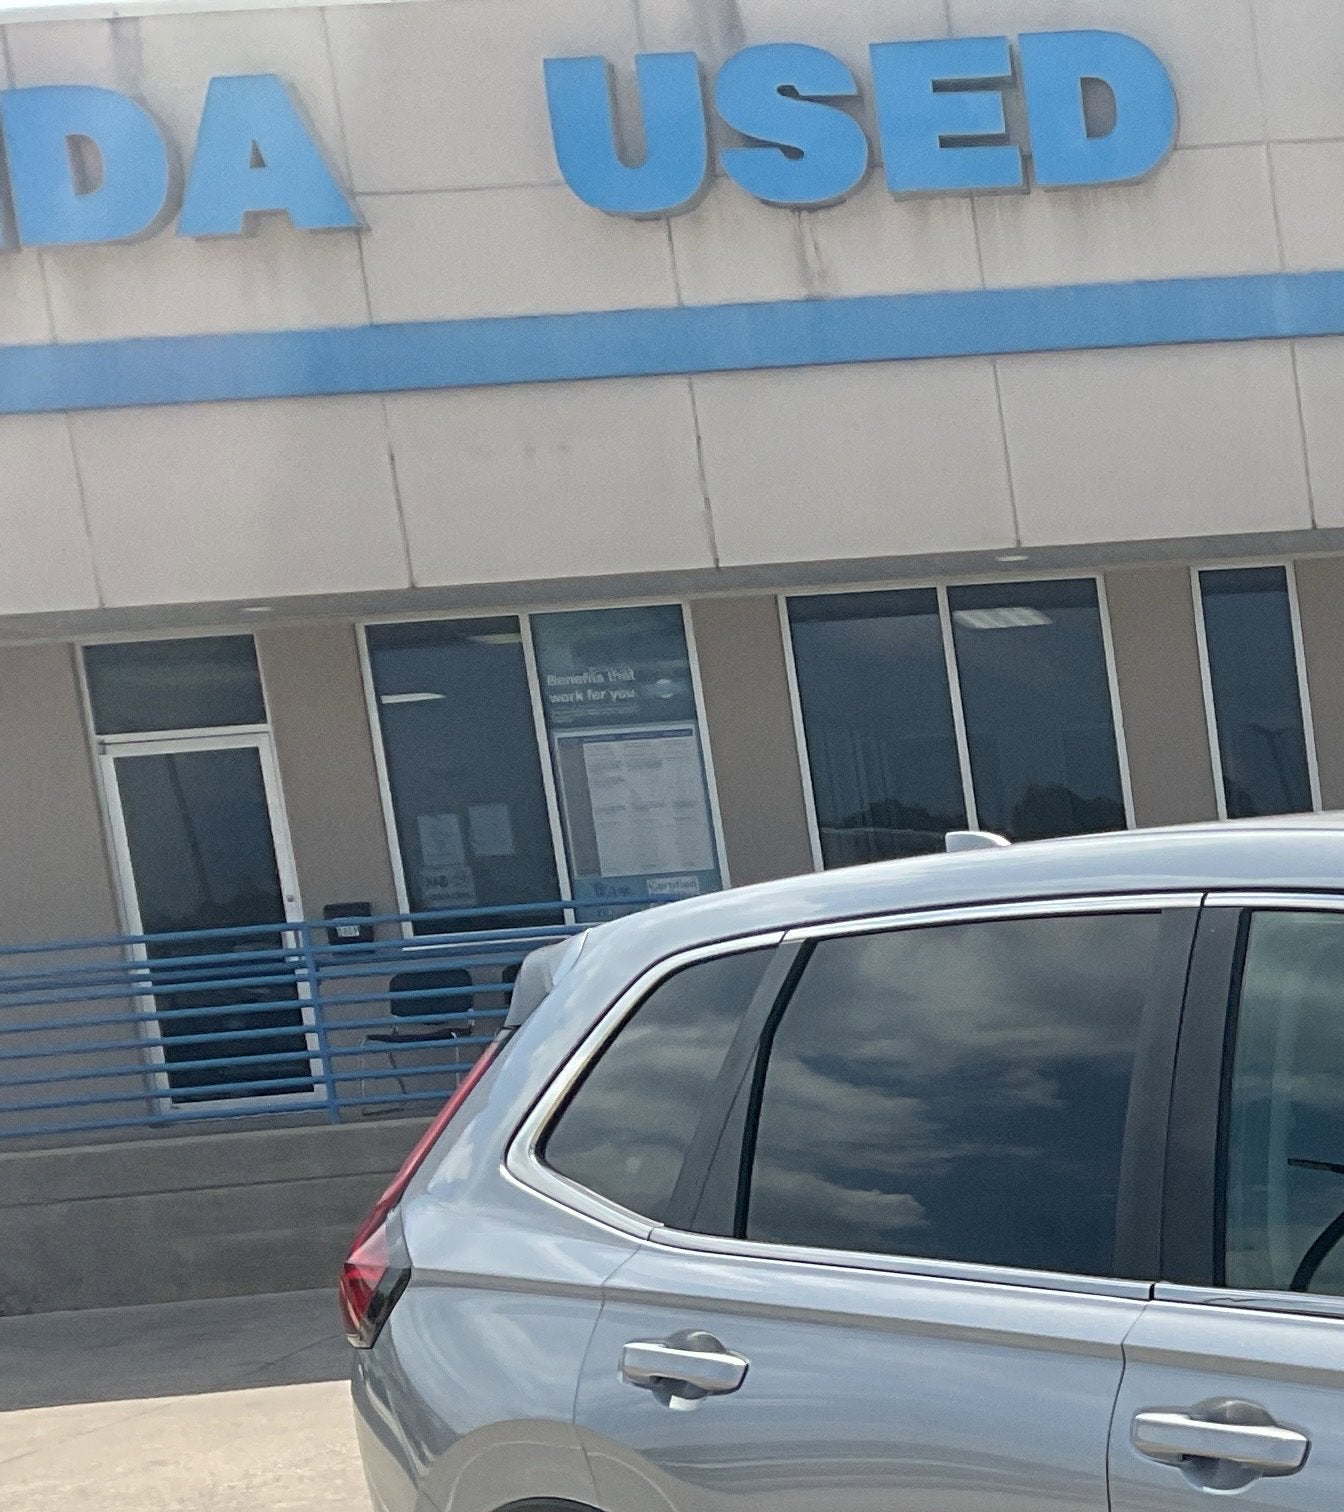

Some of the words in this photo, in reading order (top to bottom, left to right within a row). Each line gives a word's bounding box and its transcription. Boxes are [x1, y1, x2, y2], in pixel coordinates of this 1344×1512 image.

[0, 73, 363, 252] DA
[543, 29, 1180, 220] USED
[549, 690, 584, 704] work
[588, 689, 606, 701] for
[609, 688, 636, 703] you
